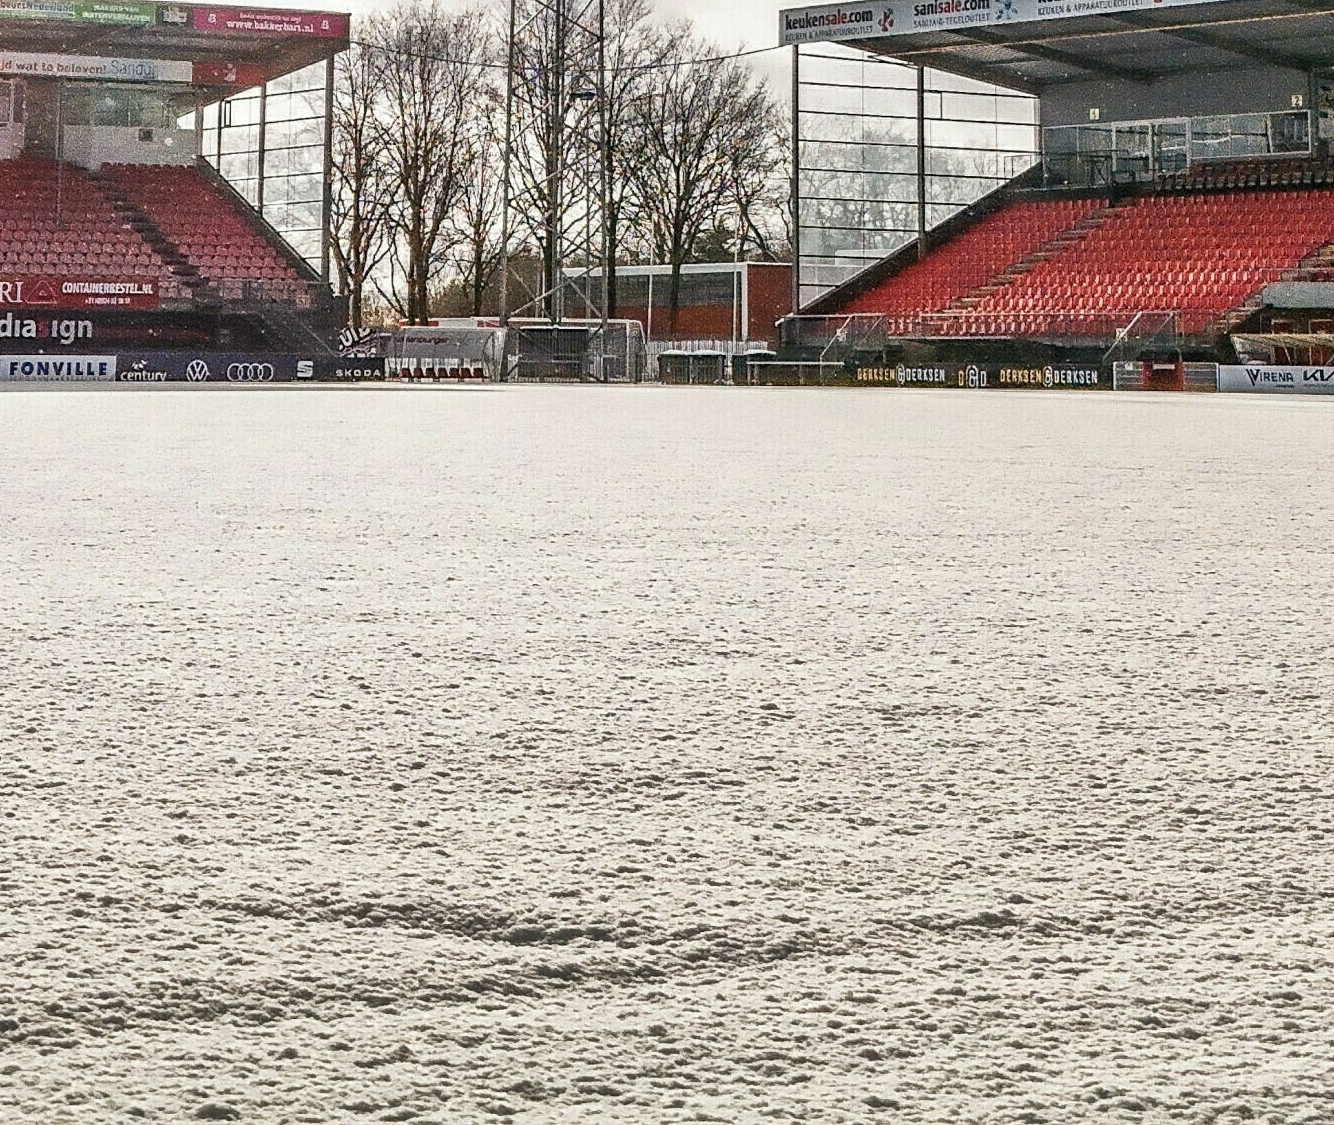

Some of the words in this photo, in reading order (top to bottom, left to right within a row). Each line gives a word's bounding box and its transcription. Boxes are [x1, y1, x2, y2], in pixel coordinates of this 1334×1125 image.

[785, 9, 873, 31] keukensale.com
[16, 61, 38, 72] wat
[62, 282, 153, 295] CONTAINERBESTEL.NL
[9, 361, 108, 376] FONVILLE
[857, 368, 895, 381] DERKSEN
[905, 368, 945, 382] DERKSEN
[120, 370, 167, 382] century
[1000, 369, 1042, 383] DERKSEN
[1053, 370, 1098, 383] DERKSEN
[1245, 368, 1294, 386] VIRENA
